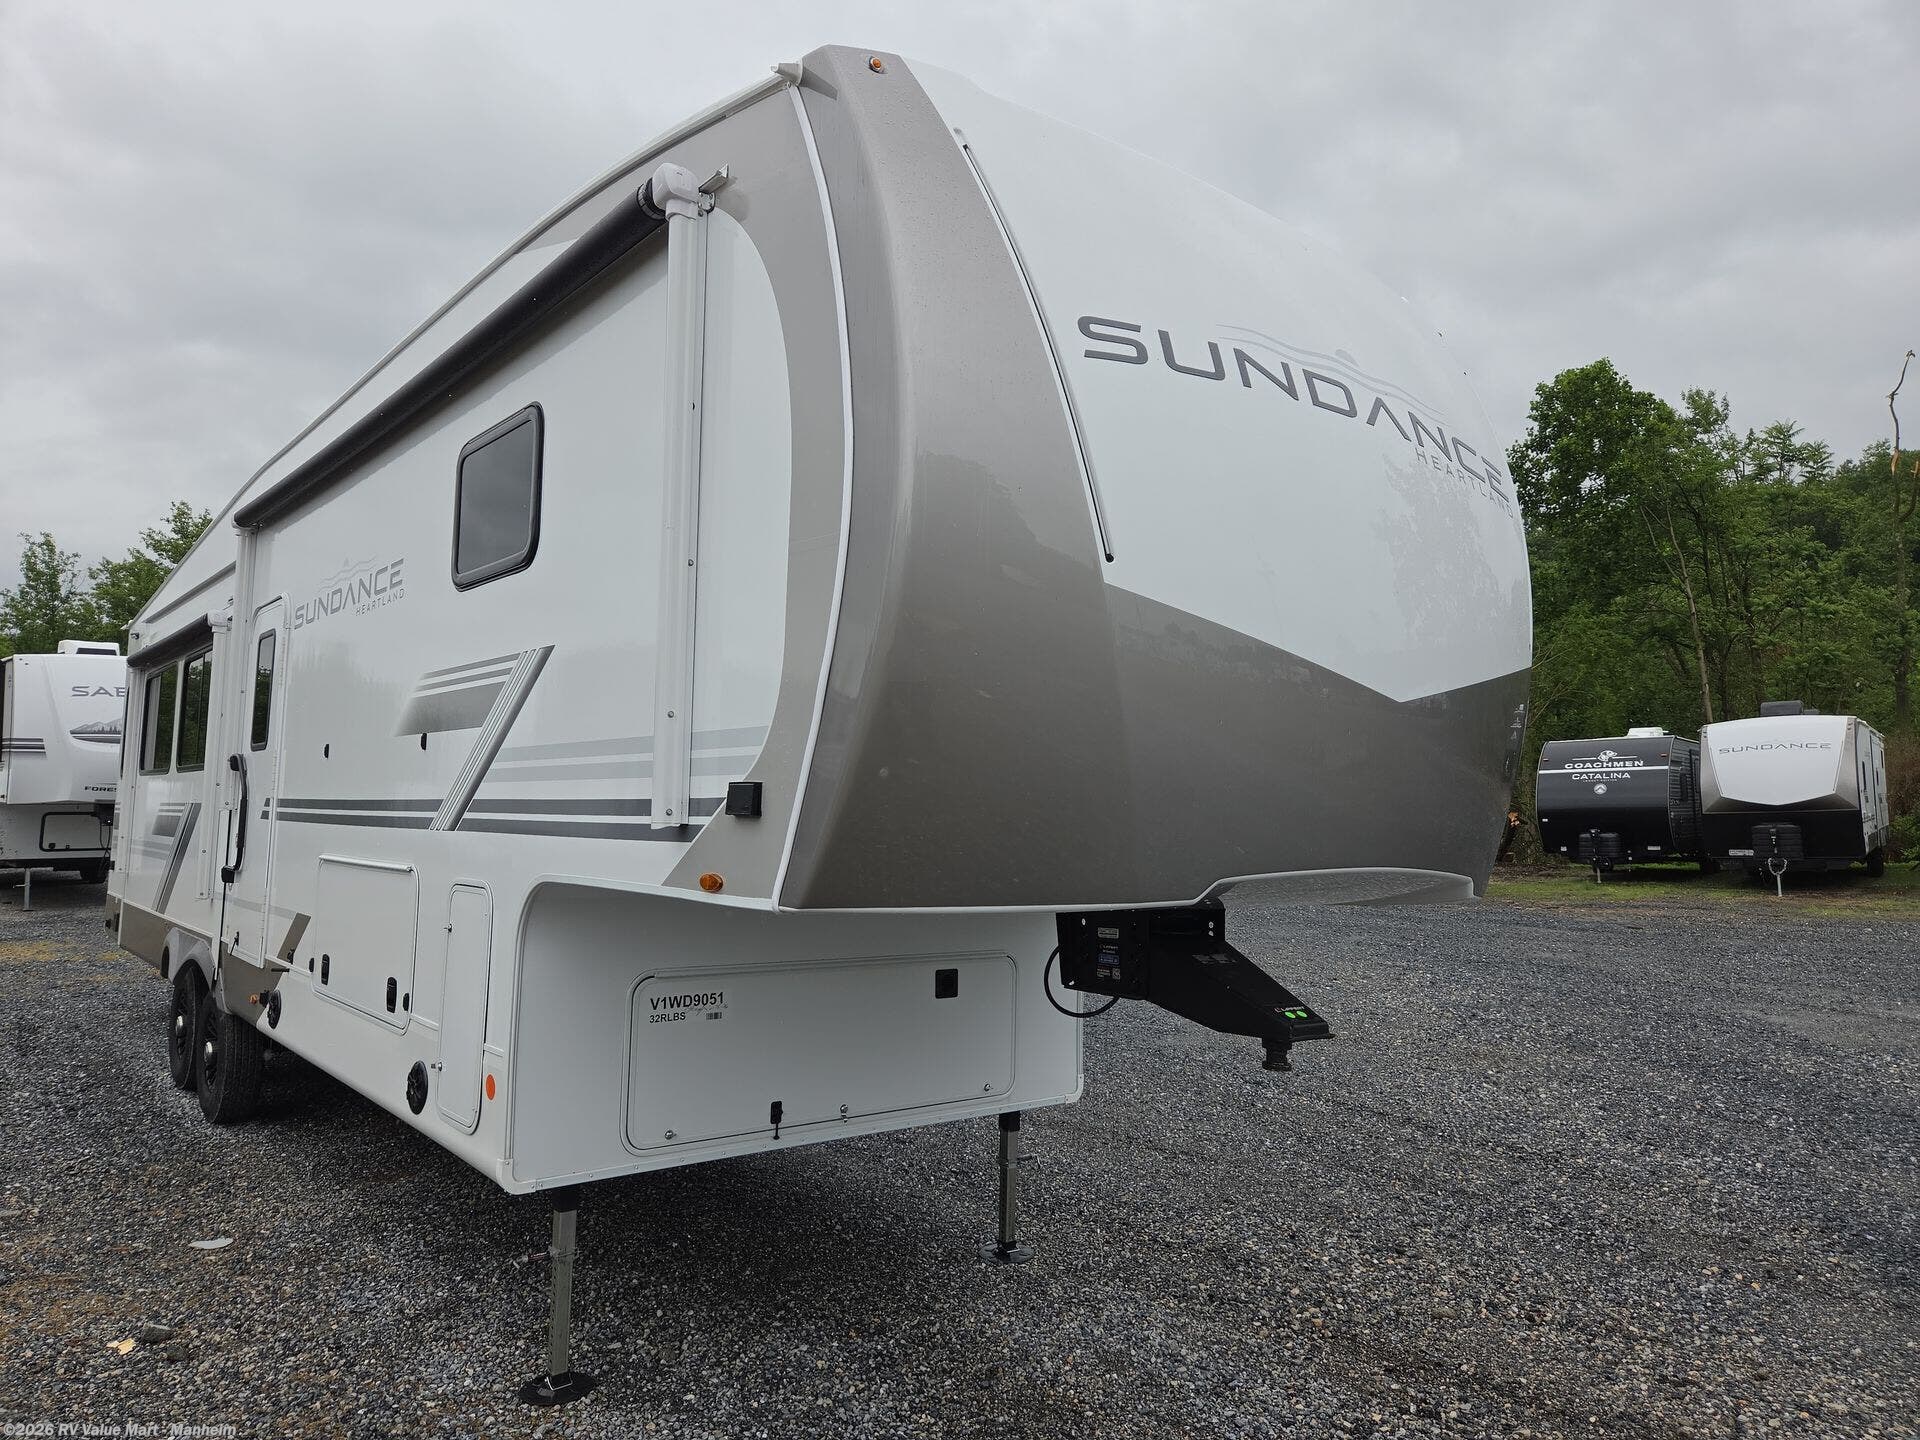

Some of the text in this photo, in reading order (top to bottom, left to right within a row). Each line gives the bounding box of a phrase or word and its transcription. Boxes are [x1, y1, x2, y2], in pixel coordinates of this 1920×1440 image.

[1077, 315, 1510, 504] SUNDANCE
[1415, 447, 1514, 520] HEARTLAND
[293, 558, 404, 630] SUNDANCE
[355, 588, 405, 616] HEARTLAND
[1719, 742, 1832, 755] SUNDANCE
[1564, 760, 1644, 769] COACHMEN
[1571, 772, 1631, 780] CATALINA
[650, 992, 723, 1010] V1WD9051
[649, 1012, 686, 1023] 32RLBS
